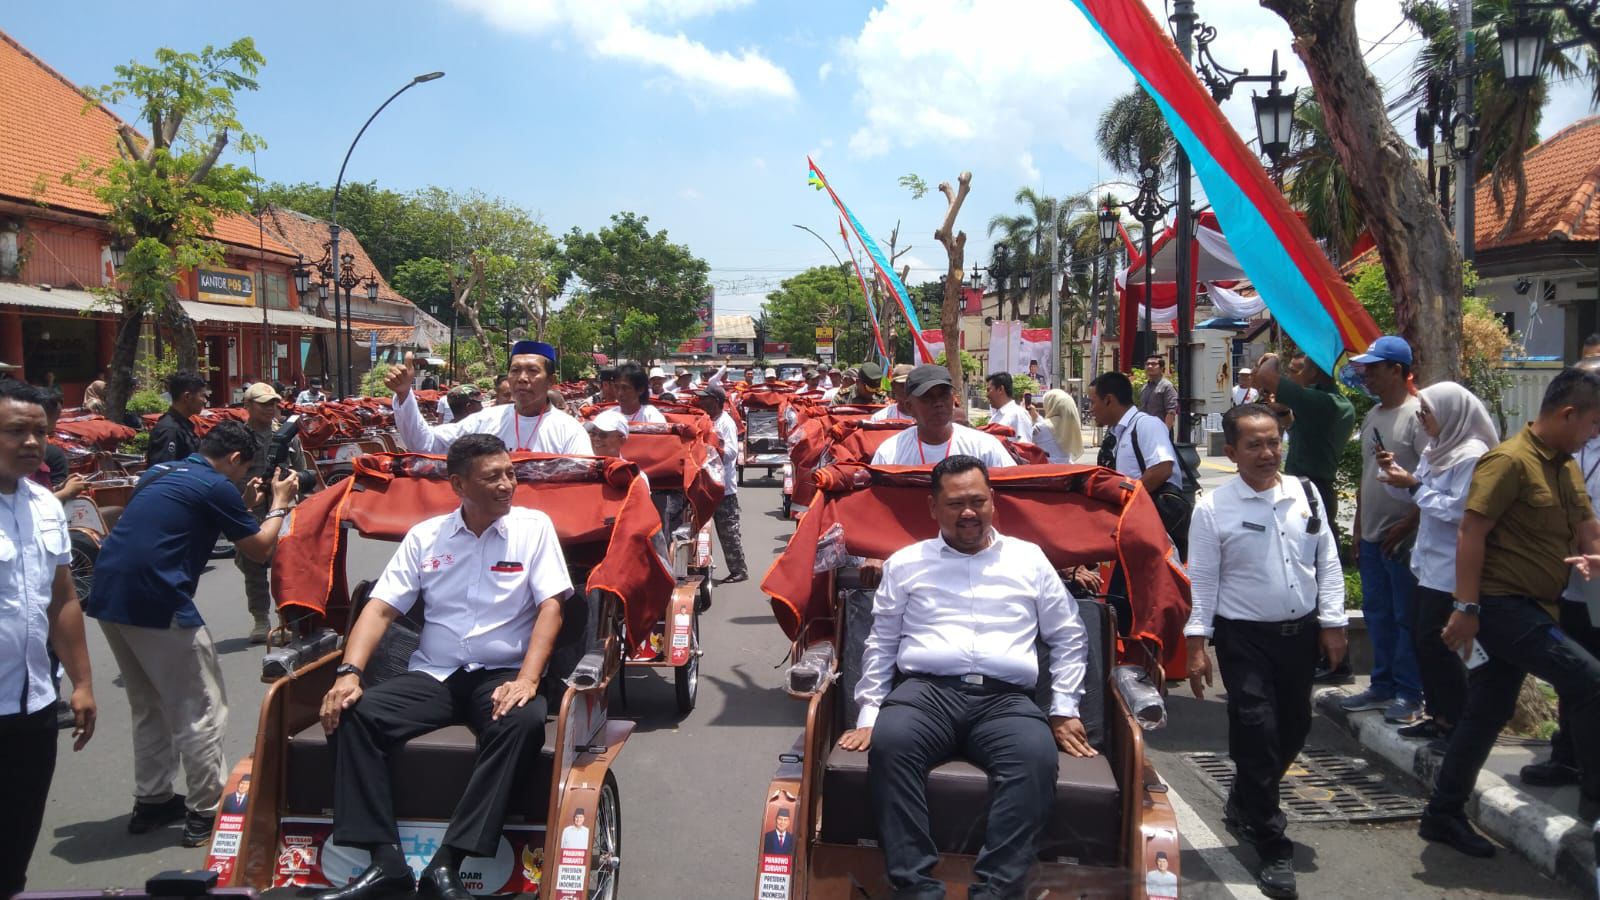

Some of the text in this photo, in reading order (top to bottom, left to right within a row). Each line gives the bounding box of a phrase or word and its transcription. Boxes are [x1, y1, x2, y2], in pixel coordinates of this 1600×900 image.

[201, 274, 242, 291] KANTOR POS
[460, 872, 482, 880] DARI
